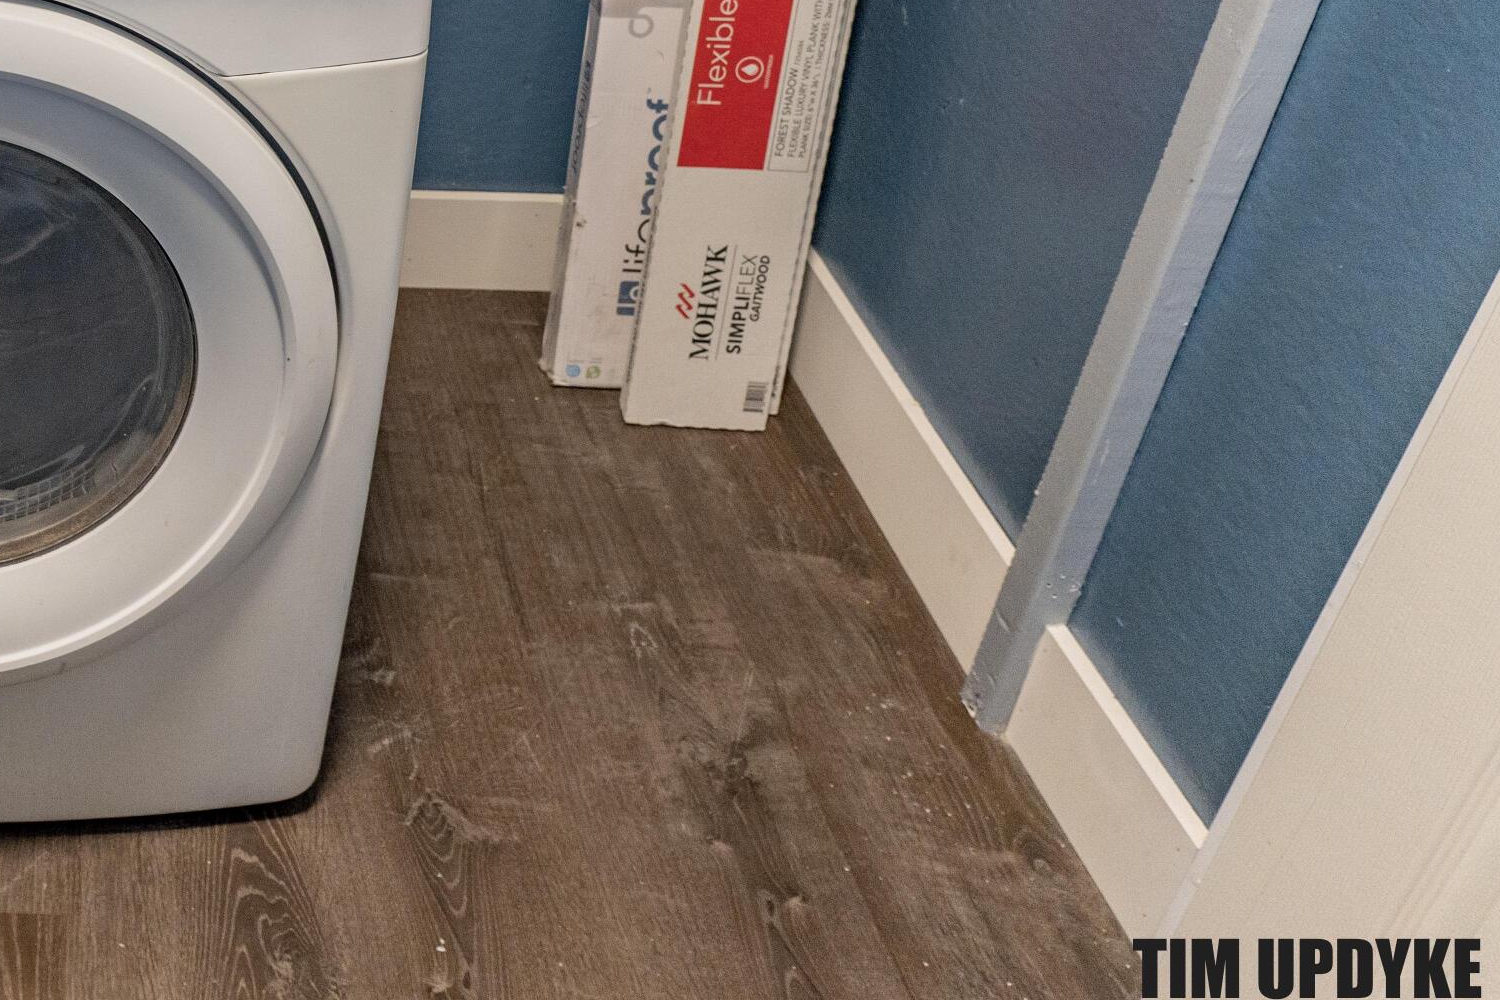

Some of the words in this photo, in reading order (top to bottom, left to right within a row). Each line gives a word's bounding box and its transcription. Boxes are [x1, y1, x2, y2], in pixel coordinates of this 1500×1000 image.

[812, 1, 823, 23] WITH
[806, 26, 818, 56] PLANK
[801, 58, 811, 84] VINYL
[775, 119, 789, 157] FOREST
[782, 68, 798, 115] SHADOW
[794, 84, 806, 116] LUXURY
[787, 120, 802, 158] FLEXIBLE
[688, 244, 729, 360] MOHAWK
[726, 254, 758, 354] SIMPLIFLEX
[749, 255, 770, 322] GAITWOOD
